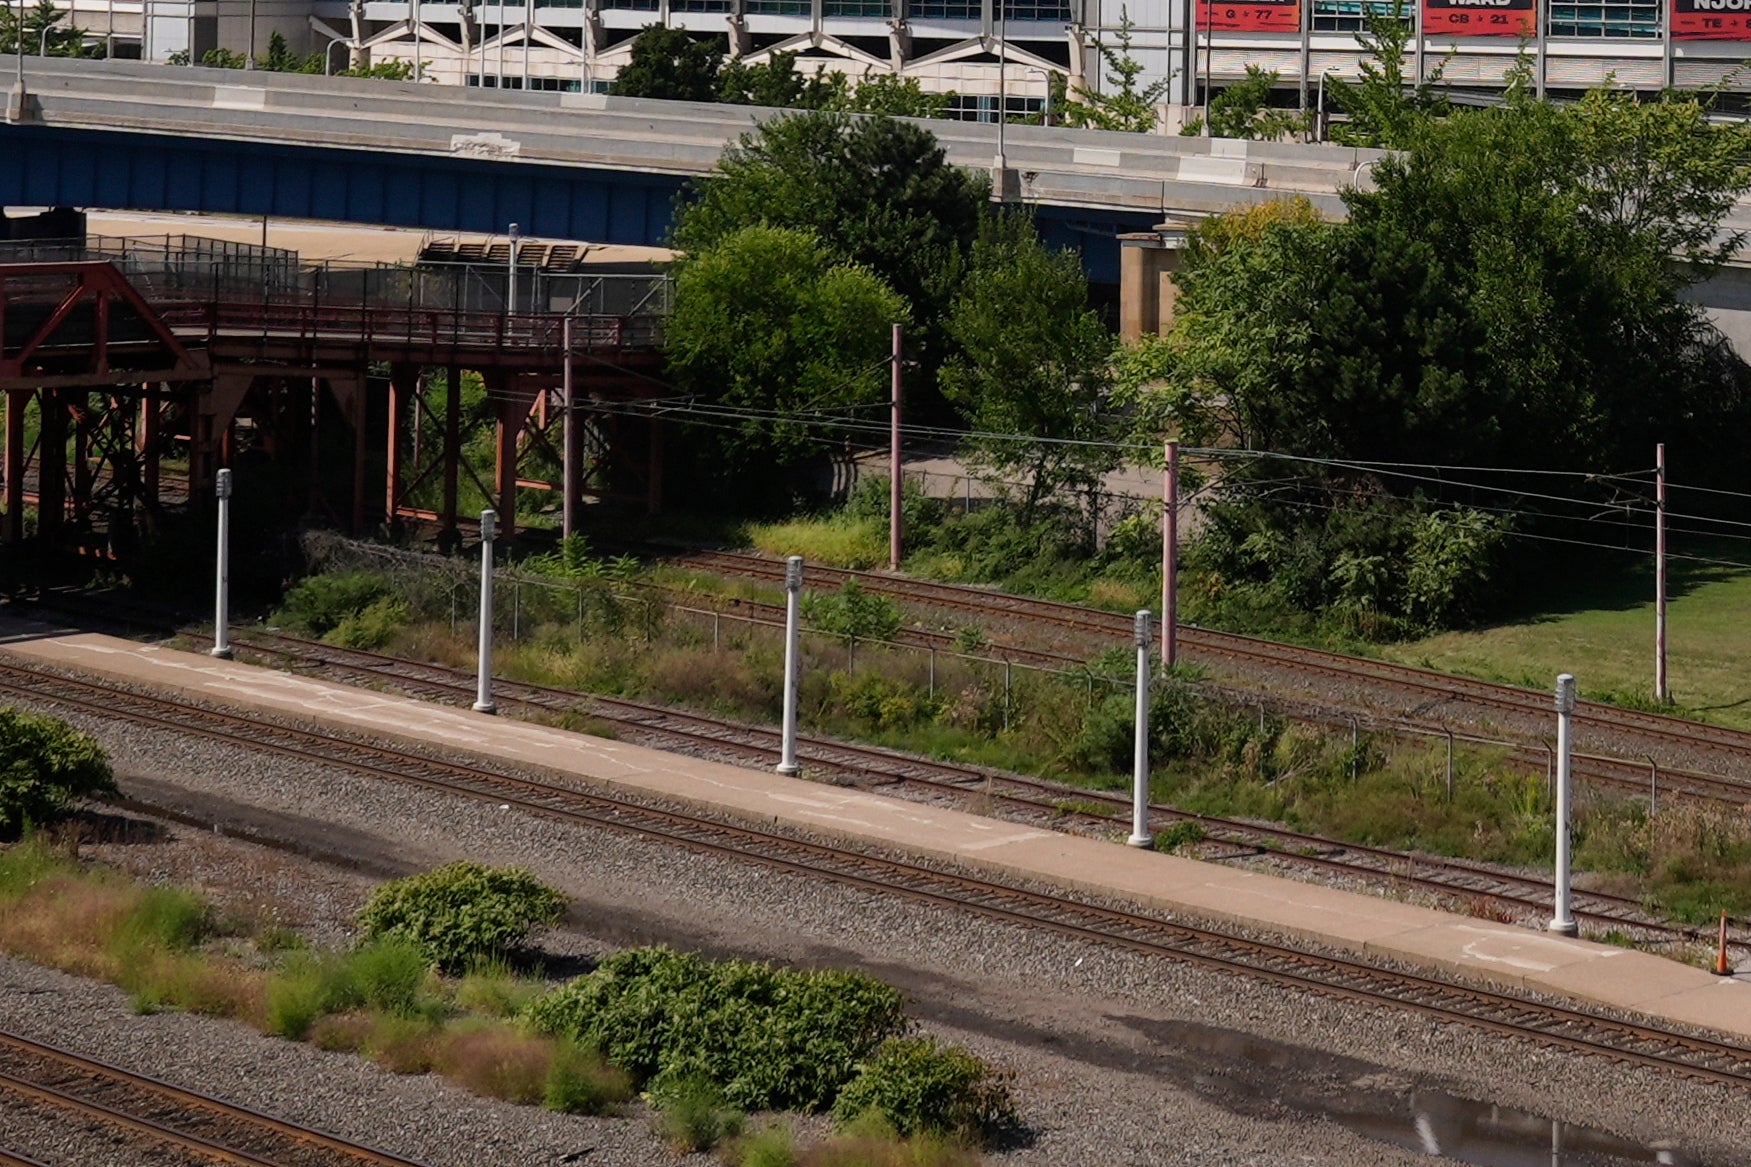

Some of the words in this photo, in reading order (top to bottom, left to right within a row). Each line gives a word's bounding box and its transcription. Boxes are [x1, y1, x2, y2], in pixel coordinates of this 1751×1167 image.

[1255, 9, 1273, 20] 77
[1448, 13, 1470, 24] CB
[1490, 14, 1509, 24] 21
[1702, 18, 1722, 29] TE
